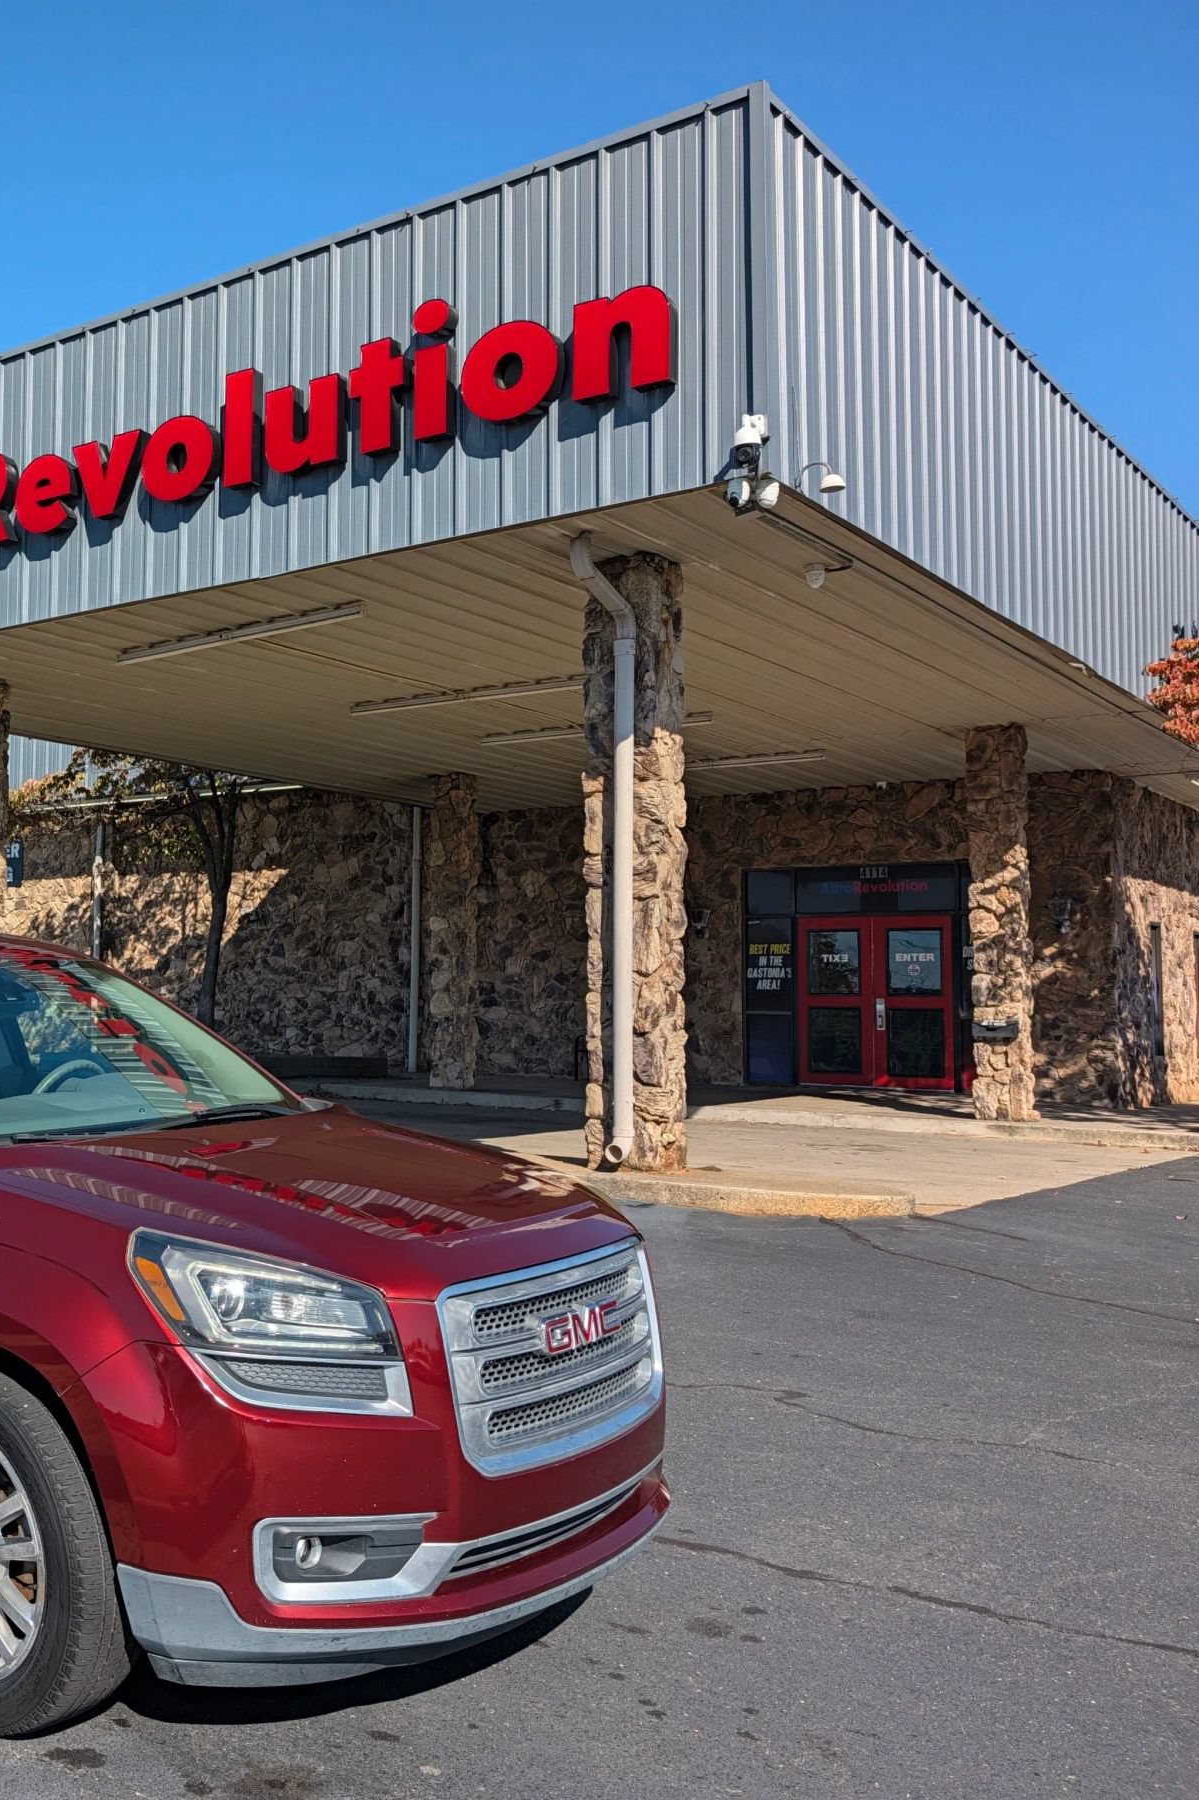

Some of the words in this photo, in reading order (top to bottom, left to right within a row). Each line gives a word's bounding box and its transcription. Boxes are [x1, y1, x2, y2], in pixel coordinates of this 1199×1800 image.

[749, 943, 768, 954] BEST
[770, 943, 791, 954] PRICE
[759, 955, 767, 966] IN
[769, 955, 783, 966] THE
[895, 953, 935, 962] ENTER
[756, 979, 781, 990] AREA!
[544, 1298, 621, 1354] GMC
